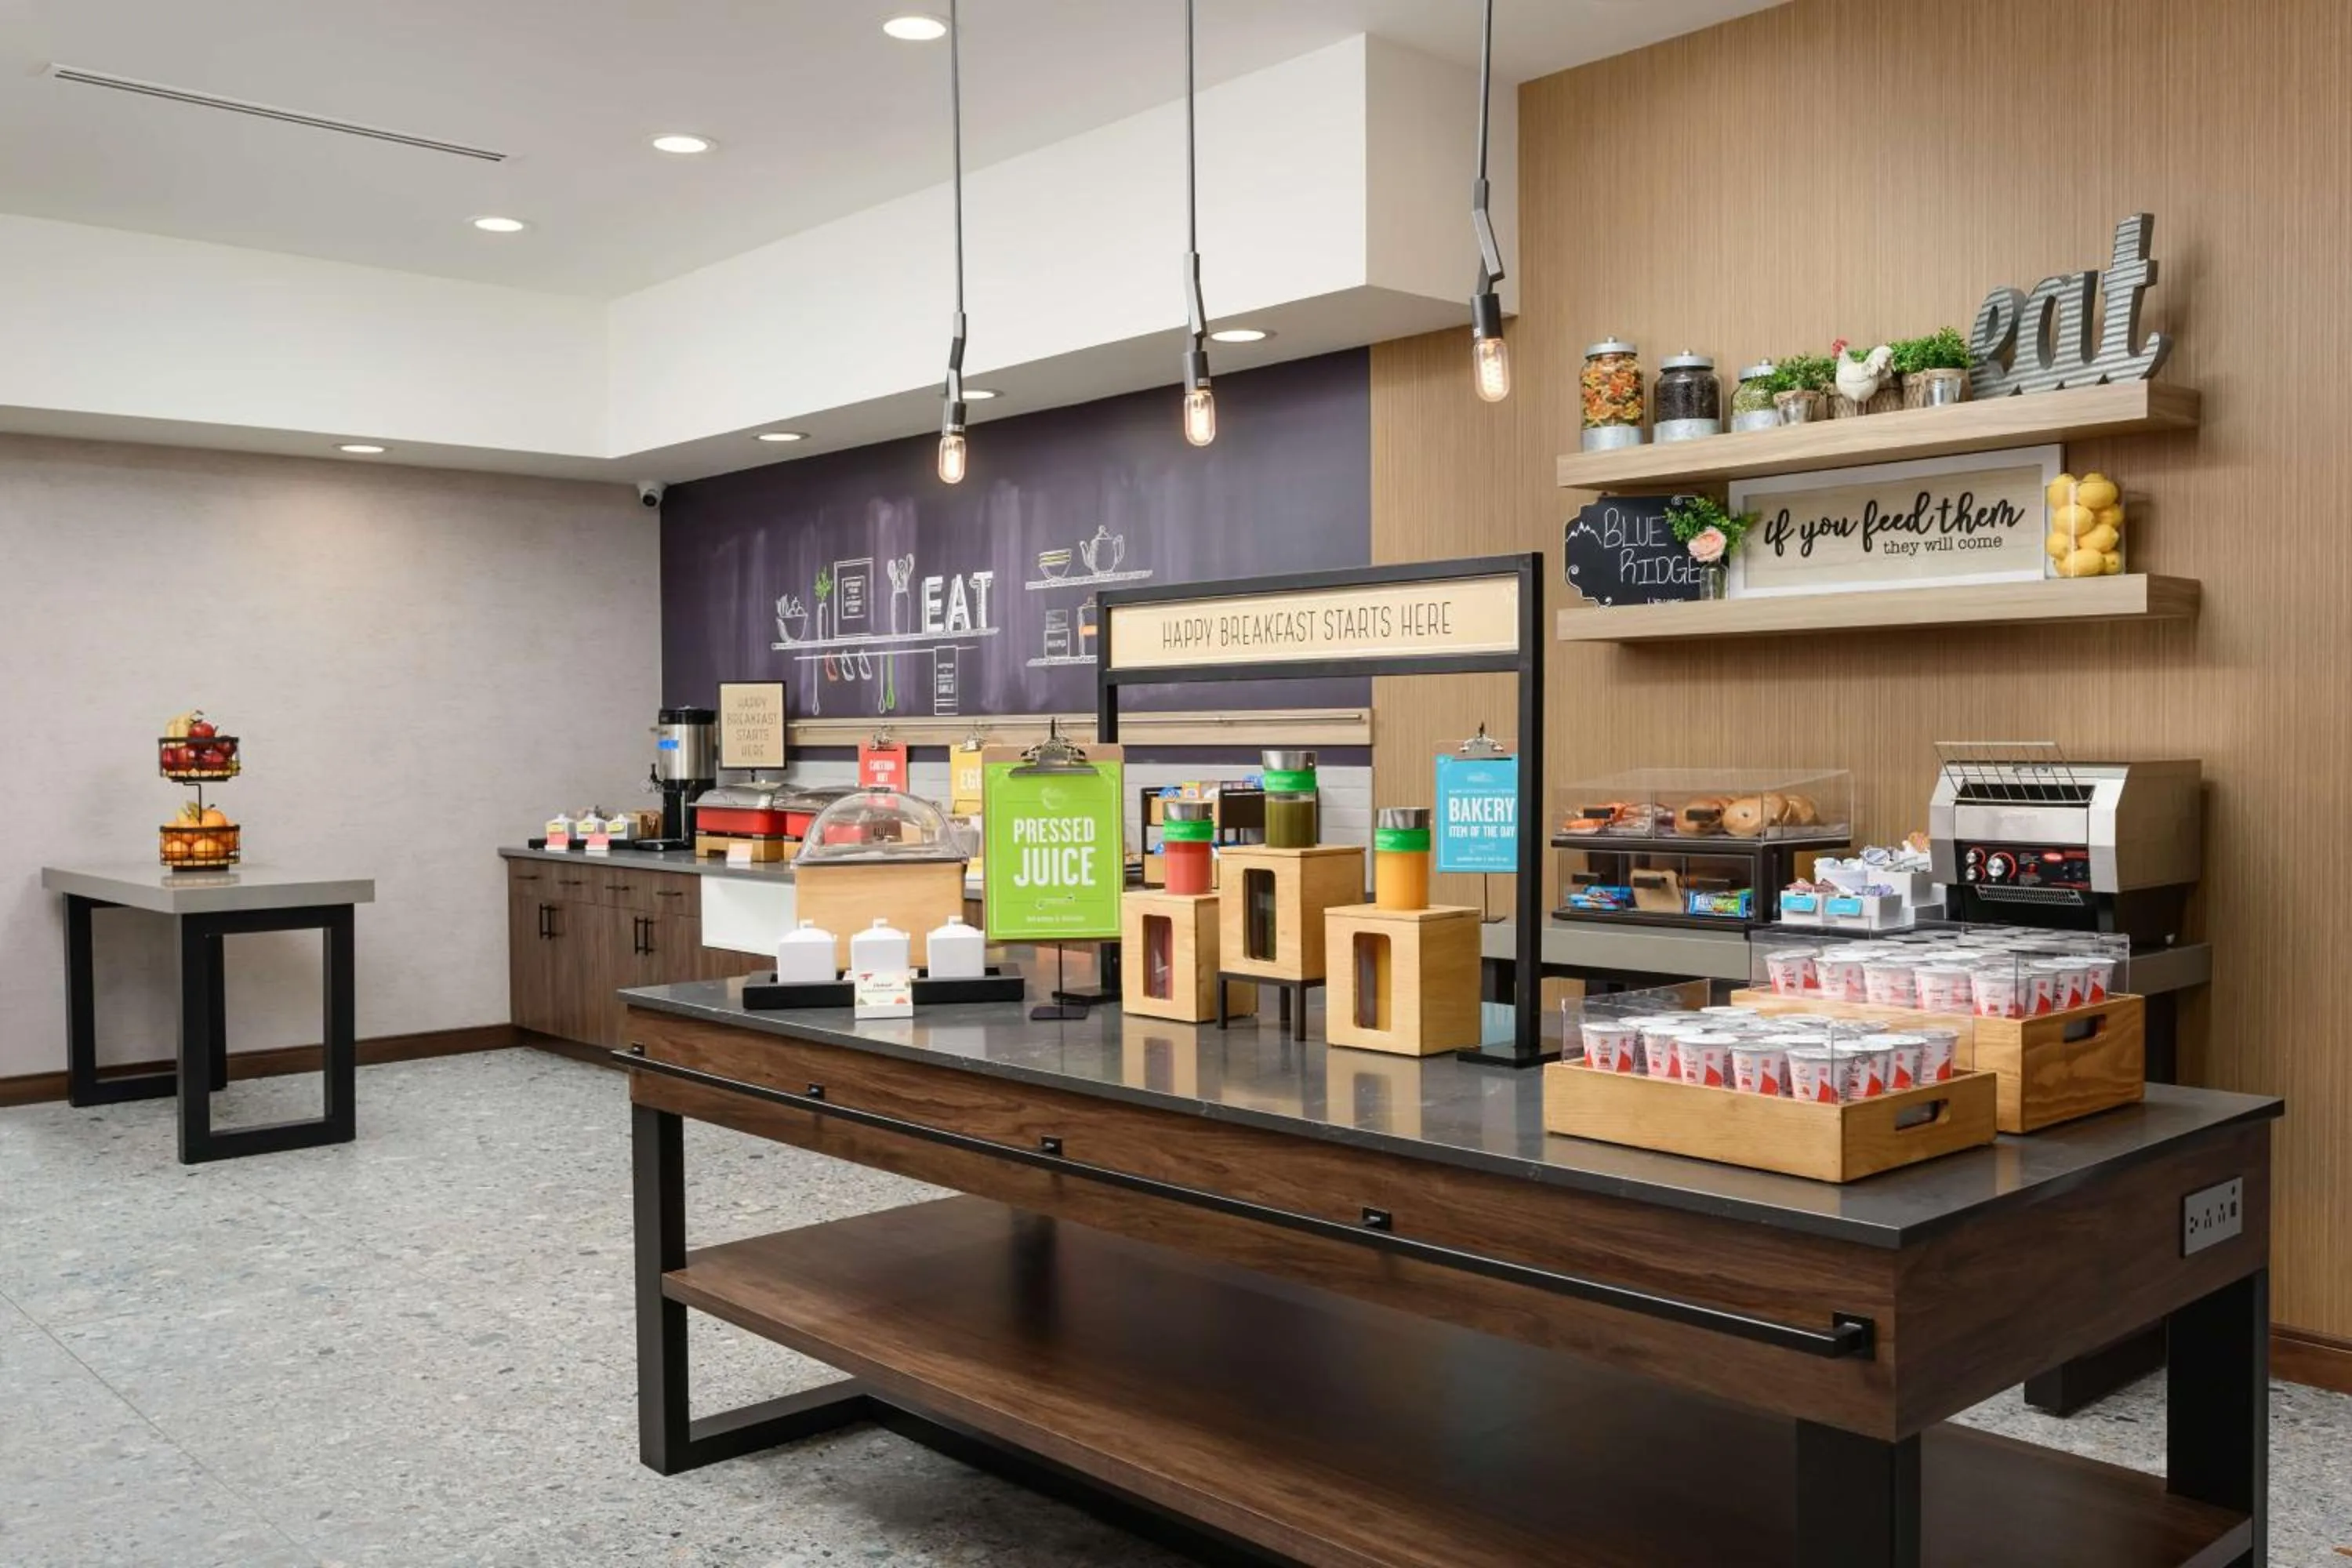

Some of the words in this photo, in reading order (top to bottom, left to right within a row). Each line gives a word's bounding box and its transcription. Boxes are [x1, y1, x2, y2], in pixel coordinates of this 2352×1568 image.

[1969, 212, 2173, 400] eat
[1604, 507, 1668, 549] BLUE
[1764, 508, 1794, 557] if
[1800, 517, 1858, 557] you
[1863, 492, 1934, 553] feed
[1936, 491, 2025, 535] them
[1883, 539, 1921, 556] they
[1925, 536, 1953, 552] will
[1958, 535, 2003, 550] come
[1620, 548, 1701, 586] RIDGE
[921, 571, 993, 633] EAT
[1162, 617, 1213, 650] HAPPY
[1220, 611, 1316, 647] BREAKFAST
[1323, 605, 1392, 641] STARTS
[1401, 601, 1453, 637] HERE
[1013, 815, 1096, 844] PRESSED
[1448, 797, 1515, 822] BAKERY
[1449, 825, 1468, 838] ITEM
[1470, 825, 1482, 838] OF
[1483, 825, 1498, 838] THE
[1501, 825, 1515, 838] DAY
[1013, 846, 1096, 887] JUICE
